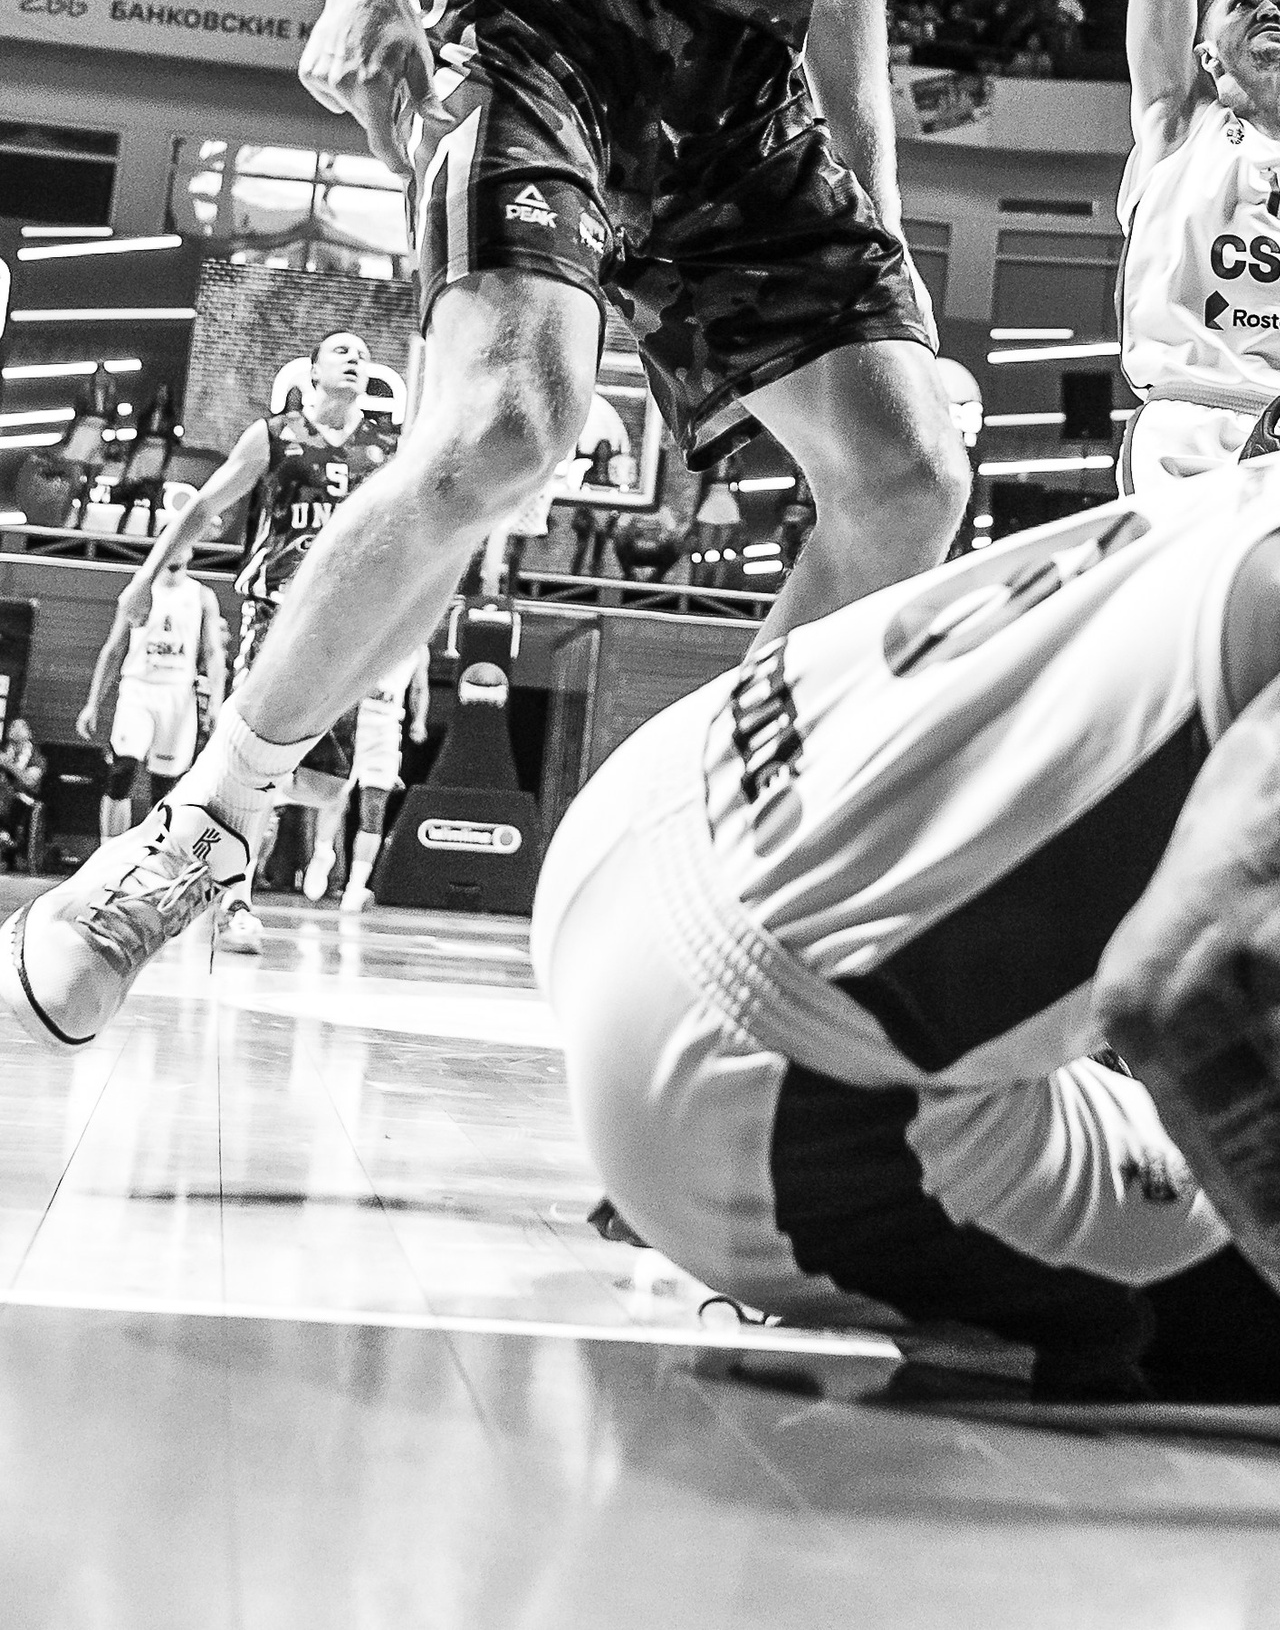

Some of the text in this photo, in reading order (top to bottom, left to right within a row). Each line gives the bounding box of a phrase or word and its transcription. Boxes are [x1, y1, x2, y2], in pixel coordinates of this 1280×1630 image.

[110, 0, 291, 40] БАНКОВСКИЕ
[505, 203, 559, 229] PEAK
[325, 462, 349, 497] 5
